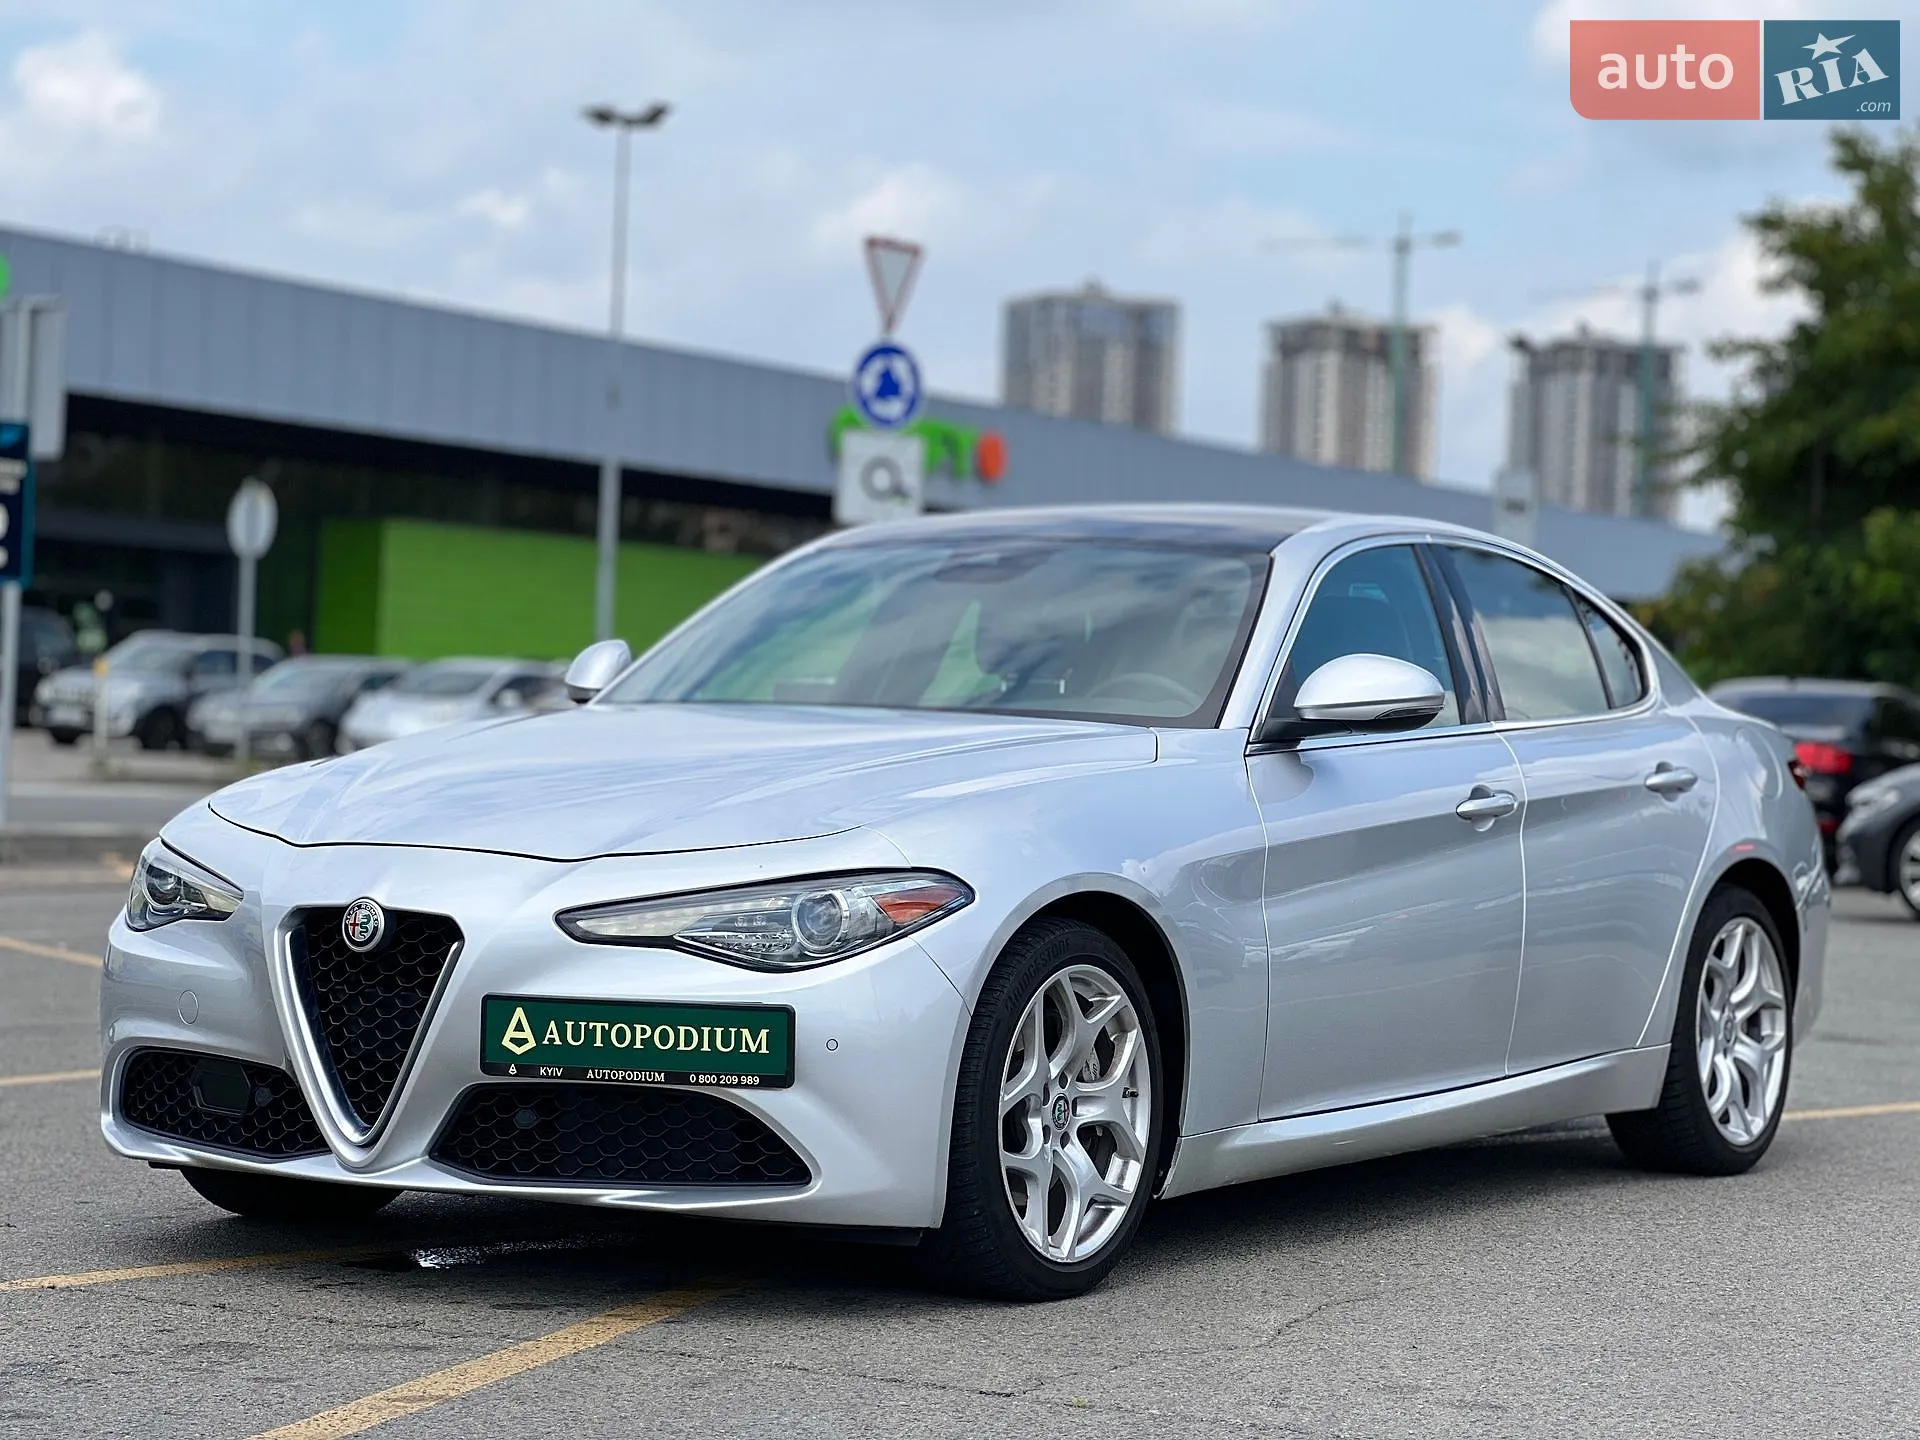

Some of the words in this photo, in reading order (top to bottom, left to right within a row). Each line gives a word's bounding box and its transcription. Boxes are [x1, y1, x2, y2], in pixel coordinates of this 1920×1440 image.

[345, 906, 359, 924] ALFA
[361, 903, 379, 927] ROMEO
[542, 1020, 770, 1054] AUTOPODIUM
[539, 1066, 564, 1077] KYIV
[586, 1068, 666, 1082] AUTOPODIUM
[689, 1073, 697, 1083] 0
[698, 1074, 718, 1084] 800
[719, 1075, 739, 1085] 209
[740, 1075, 760, 1086] 989
